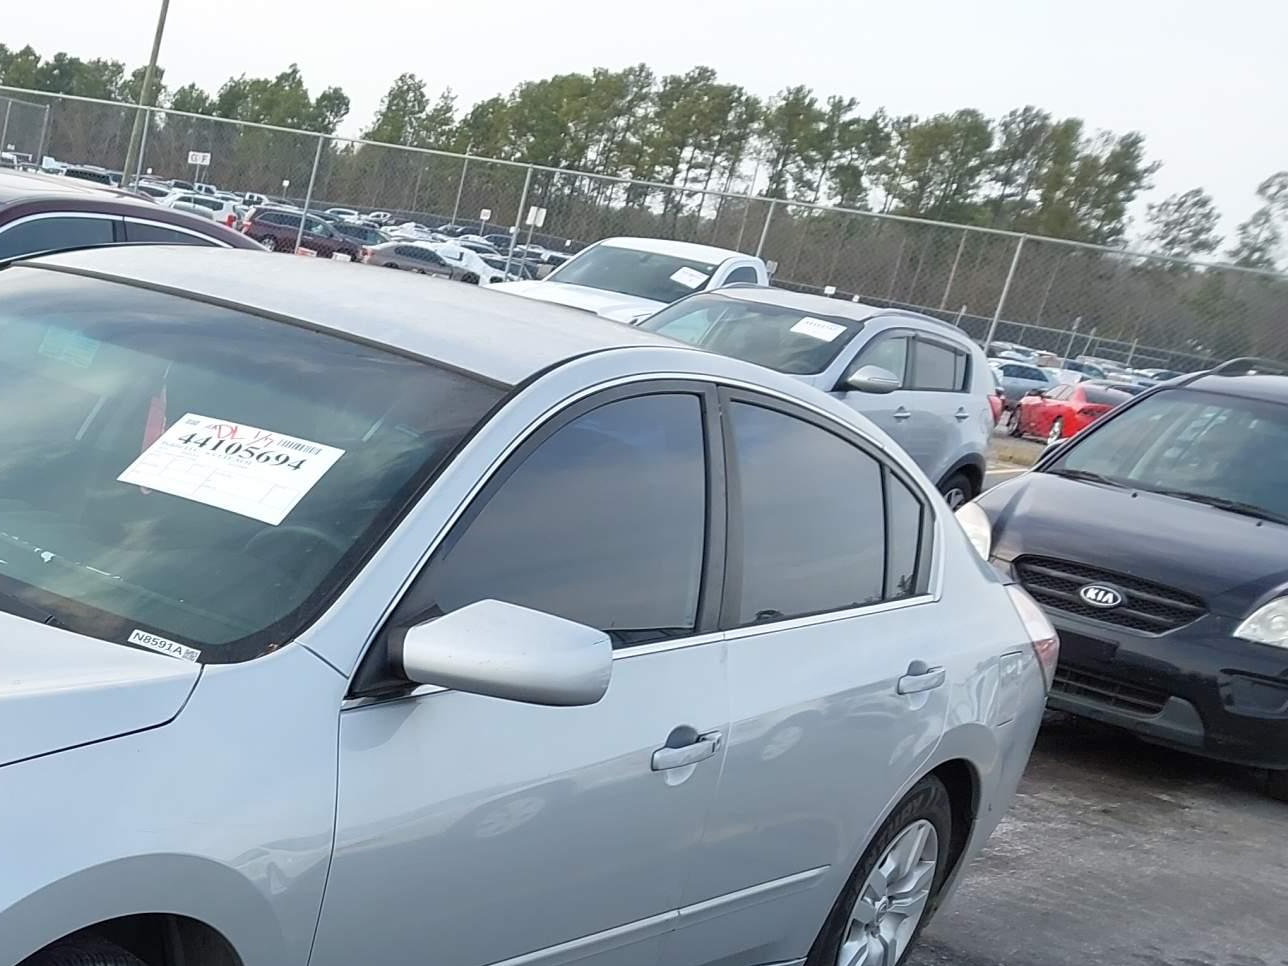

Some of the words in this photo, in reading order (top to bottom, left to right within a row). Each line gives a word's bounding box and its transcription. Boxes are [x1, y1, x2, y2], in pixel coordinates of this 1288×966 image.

[178, 433, 307, 471] 44105694
[1086, 587, 1114, 603] KIA
[133, 632, 182, 656] N8591A
